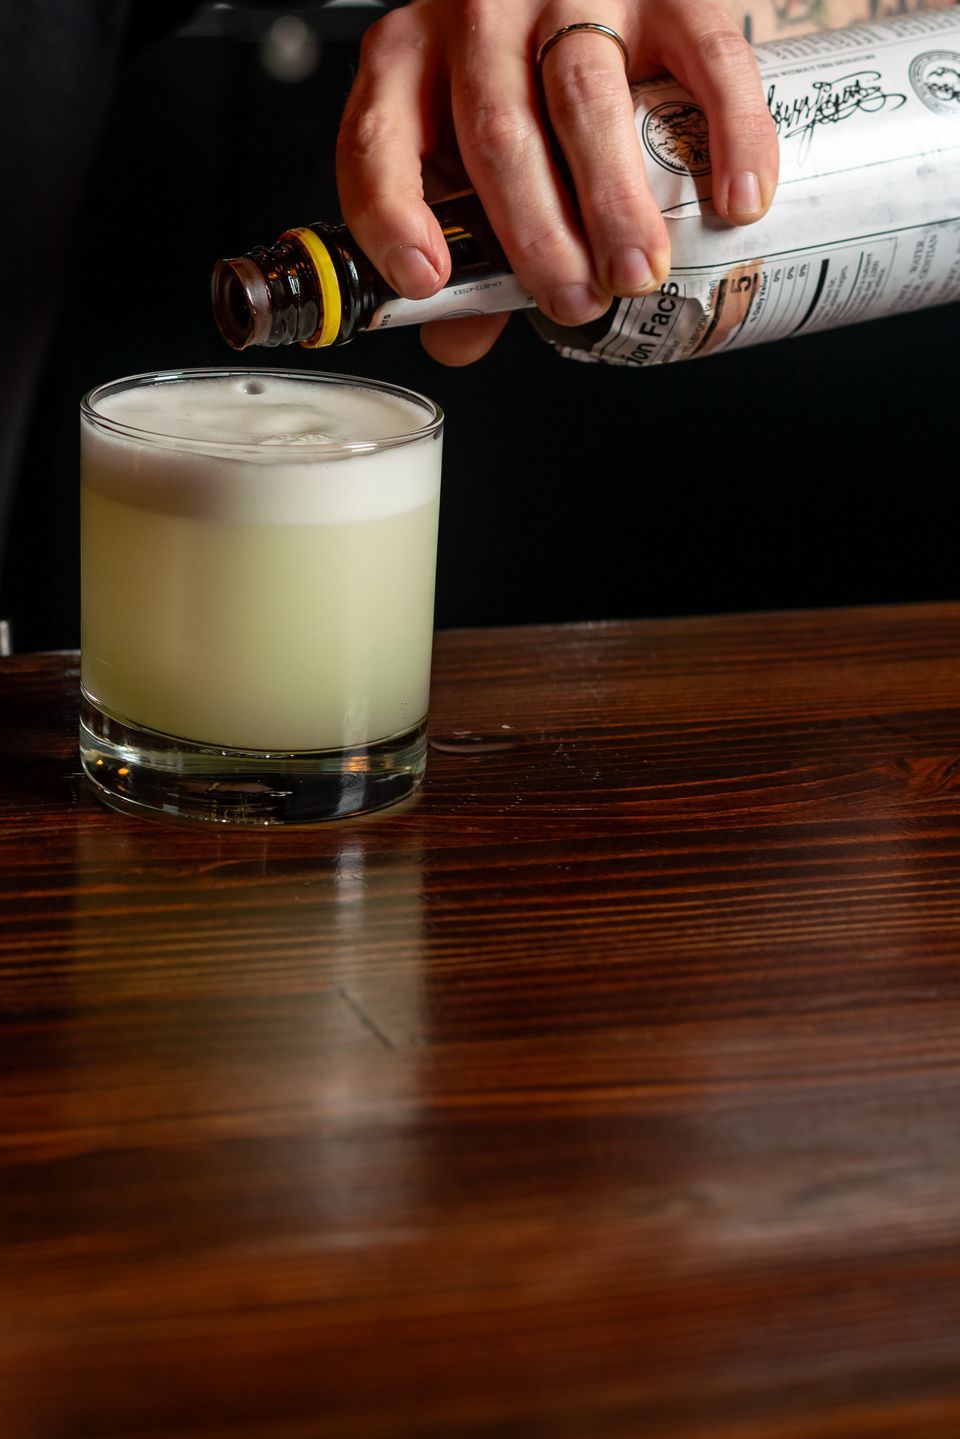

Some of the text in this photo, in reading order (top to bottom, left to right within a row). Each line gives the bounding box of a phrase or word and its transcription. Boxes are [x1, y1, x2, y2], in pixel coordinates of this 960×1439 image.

[773, 269, 781, 282] 0%
[787, 266, 795, 280] 0%
[799, 264, 807, 277] 0%
[731, 276, 752, 293] 5
[752, 298, 765, 316] Daily
[621, 282, 679, 365] ion Facs
